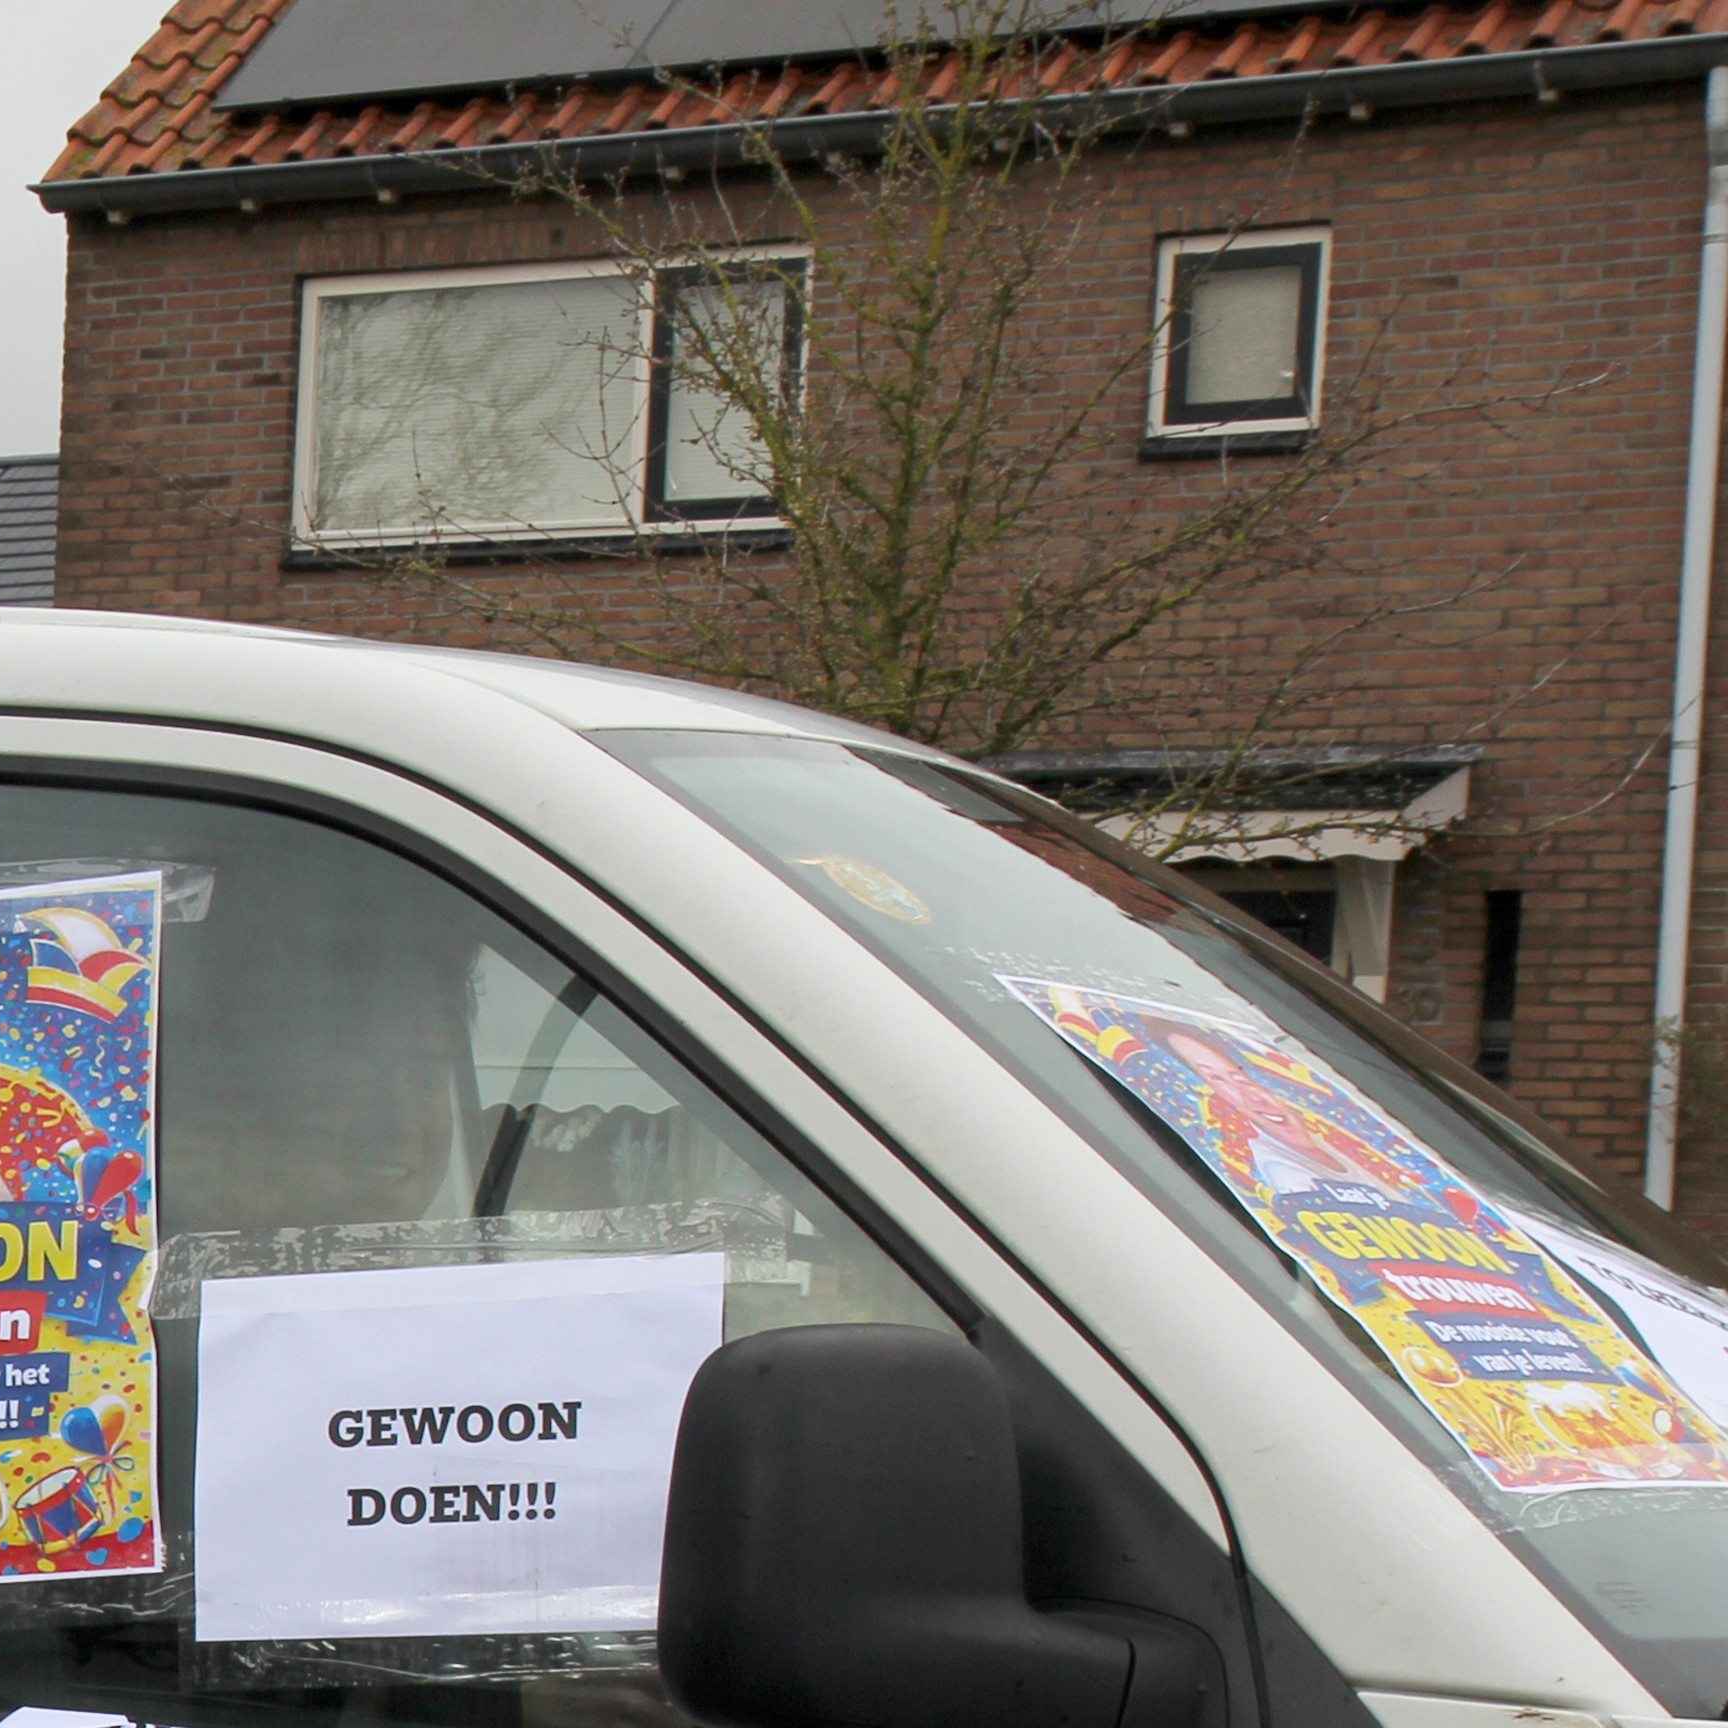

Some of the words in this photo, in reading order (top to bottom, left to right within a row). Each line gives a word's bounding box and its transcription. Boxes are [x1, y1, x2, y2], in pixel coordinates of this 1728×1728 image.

[1322, 1183, 1368, 1204] Laat
[1363, 1185, 1390, 1211] je
[1296, 1211, 1515, 1275] GEWOON
[1382, 1268, 1537, 1312] trouwen
[1424, 1321, 1463, 1342] De
[1456, 1320, 1532, 1342] mooiste
[5, 1363, 50, 1387] het
[1472, 1355, 1516, 1372] van
[328, 1401, 582, 1448] GEWOON
[347, 1481, 556, 1527] DOEN!!!
